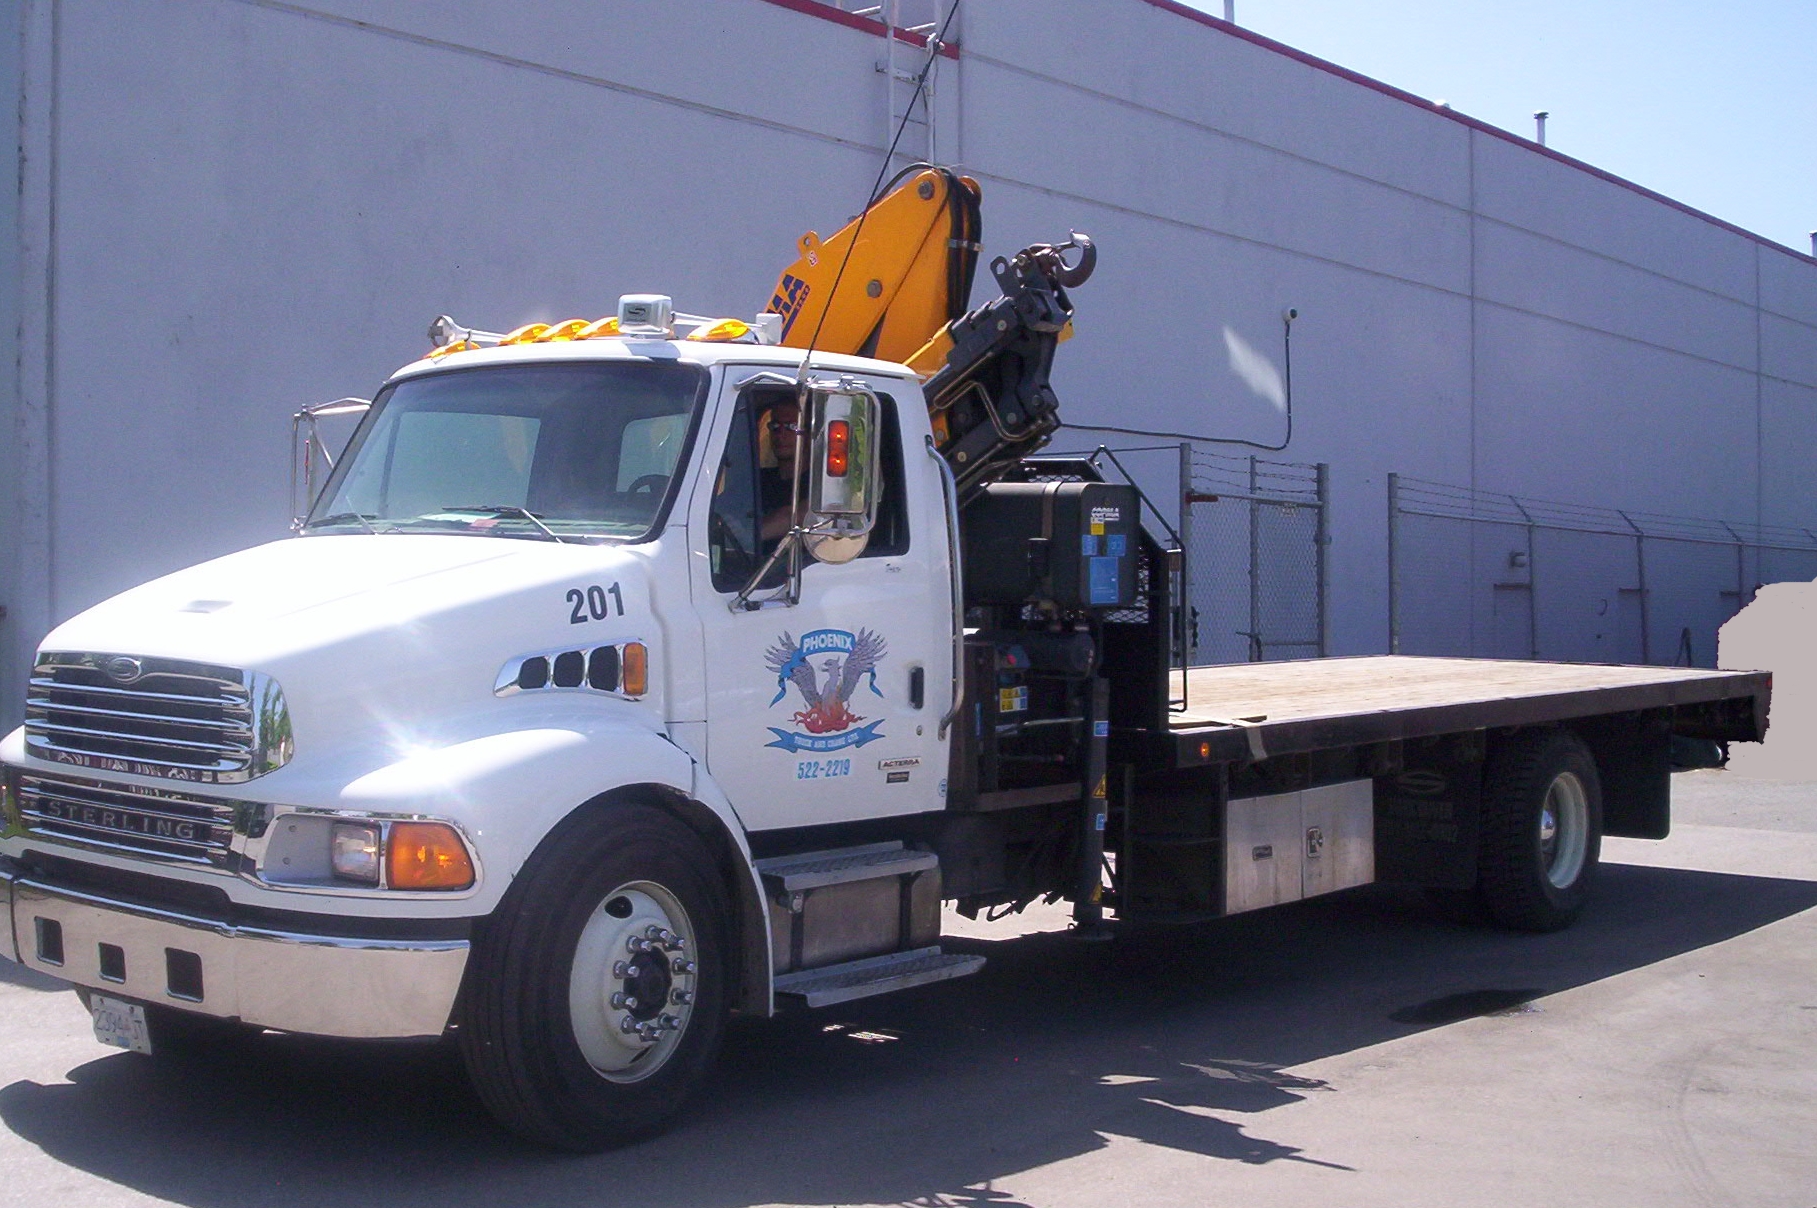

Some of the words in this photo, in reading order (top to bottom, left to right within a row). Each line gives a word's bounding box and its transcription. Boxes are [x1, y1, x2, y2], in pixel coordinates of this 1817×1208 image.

[566, 582, 624, 624] 201
[802, 633, 853, 653] PHOENIX
[797, 758, 851, 779] 522-2219
[49, 801, 195, 839] STERLING
